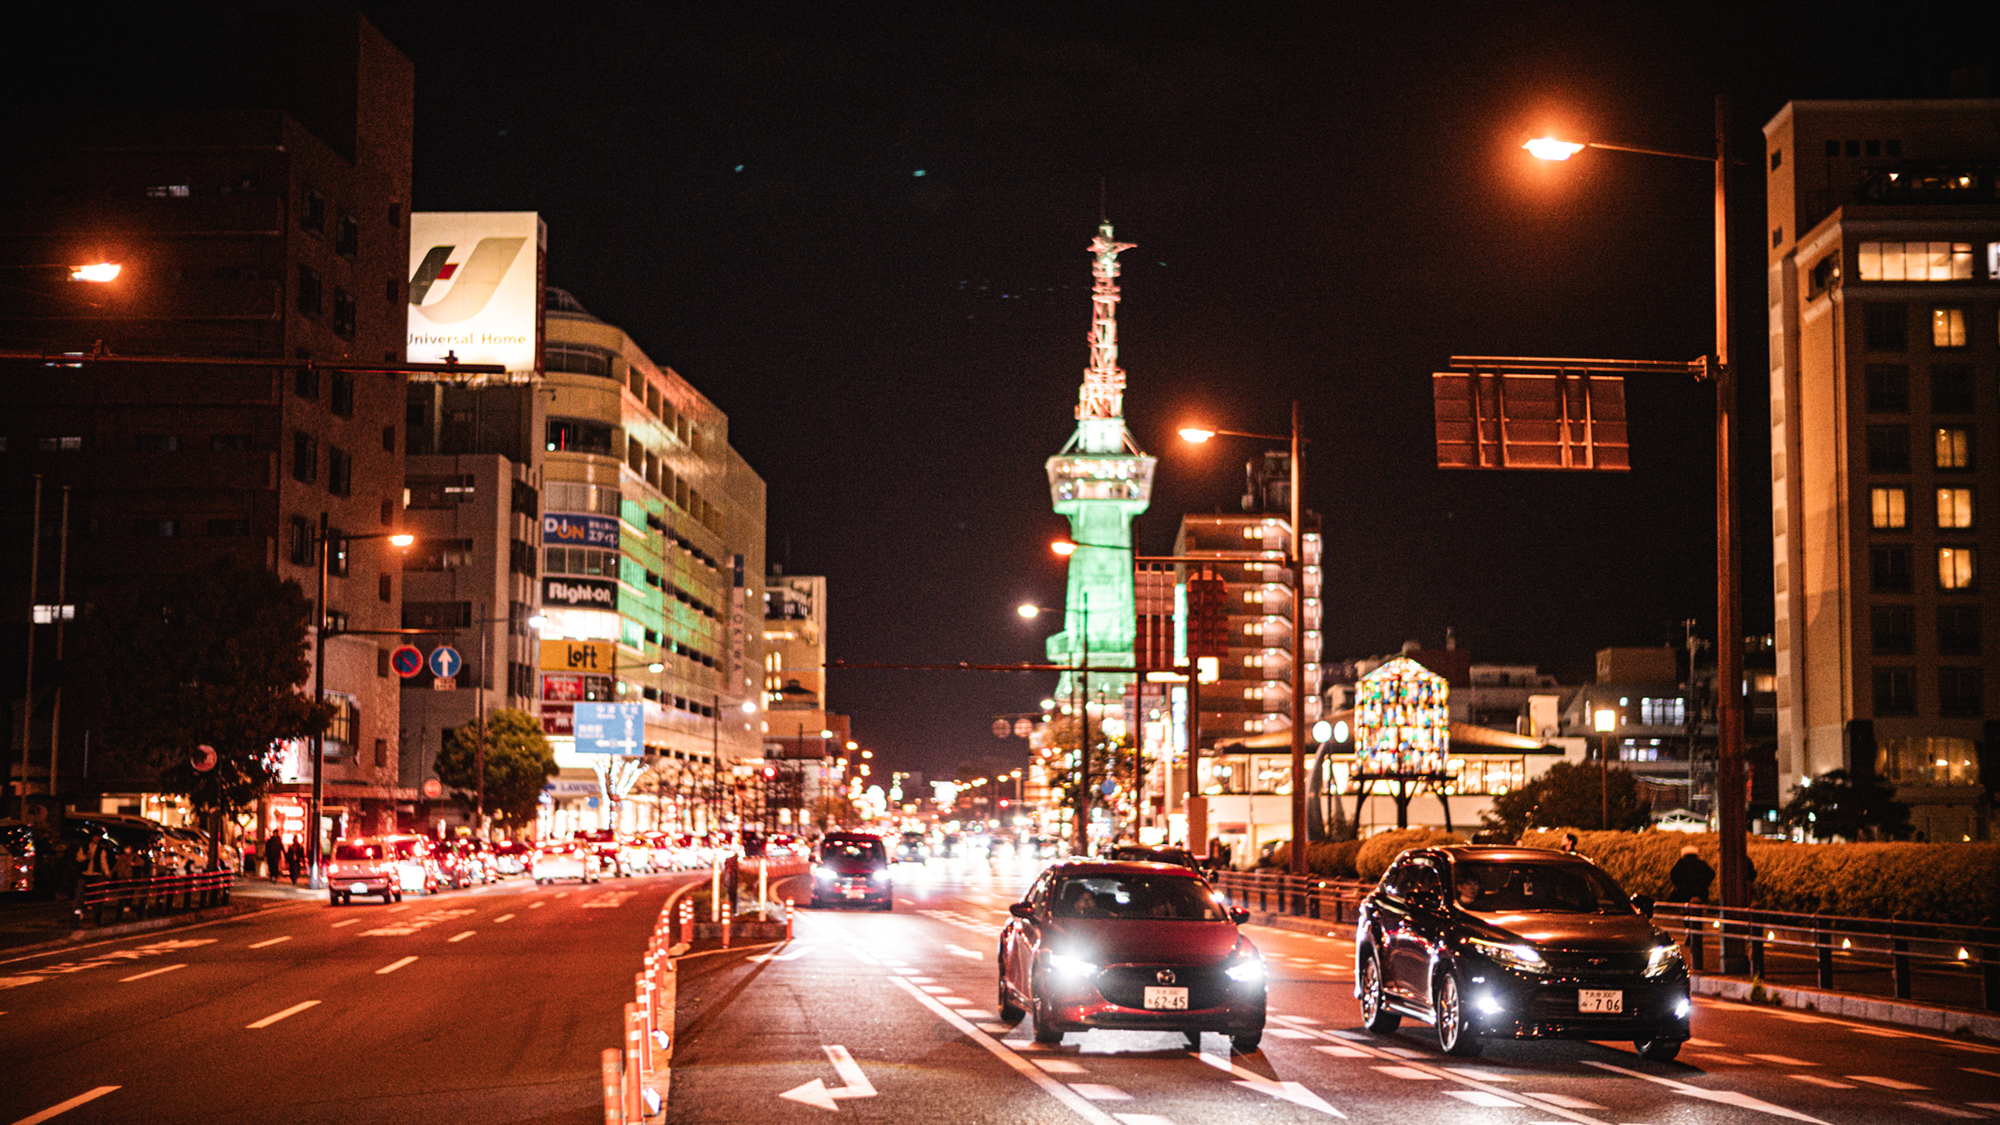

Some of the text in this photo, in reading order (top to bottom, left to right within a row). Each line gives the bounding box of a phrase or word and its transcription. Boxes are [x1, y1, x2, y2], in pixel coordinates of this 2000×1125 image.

[482, 333, 526, 345] Home
[549, 582, 611, 604] Right-on
[1154, 997, 1185, 1009] 62-45
